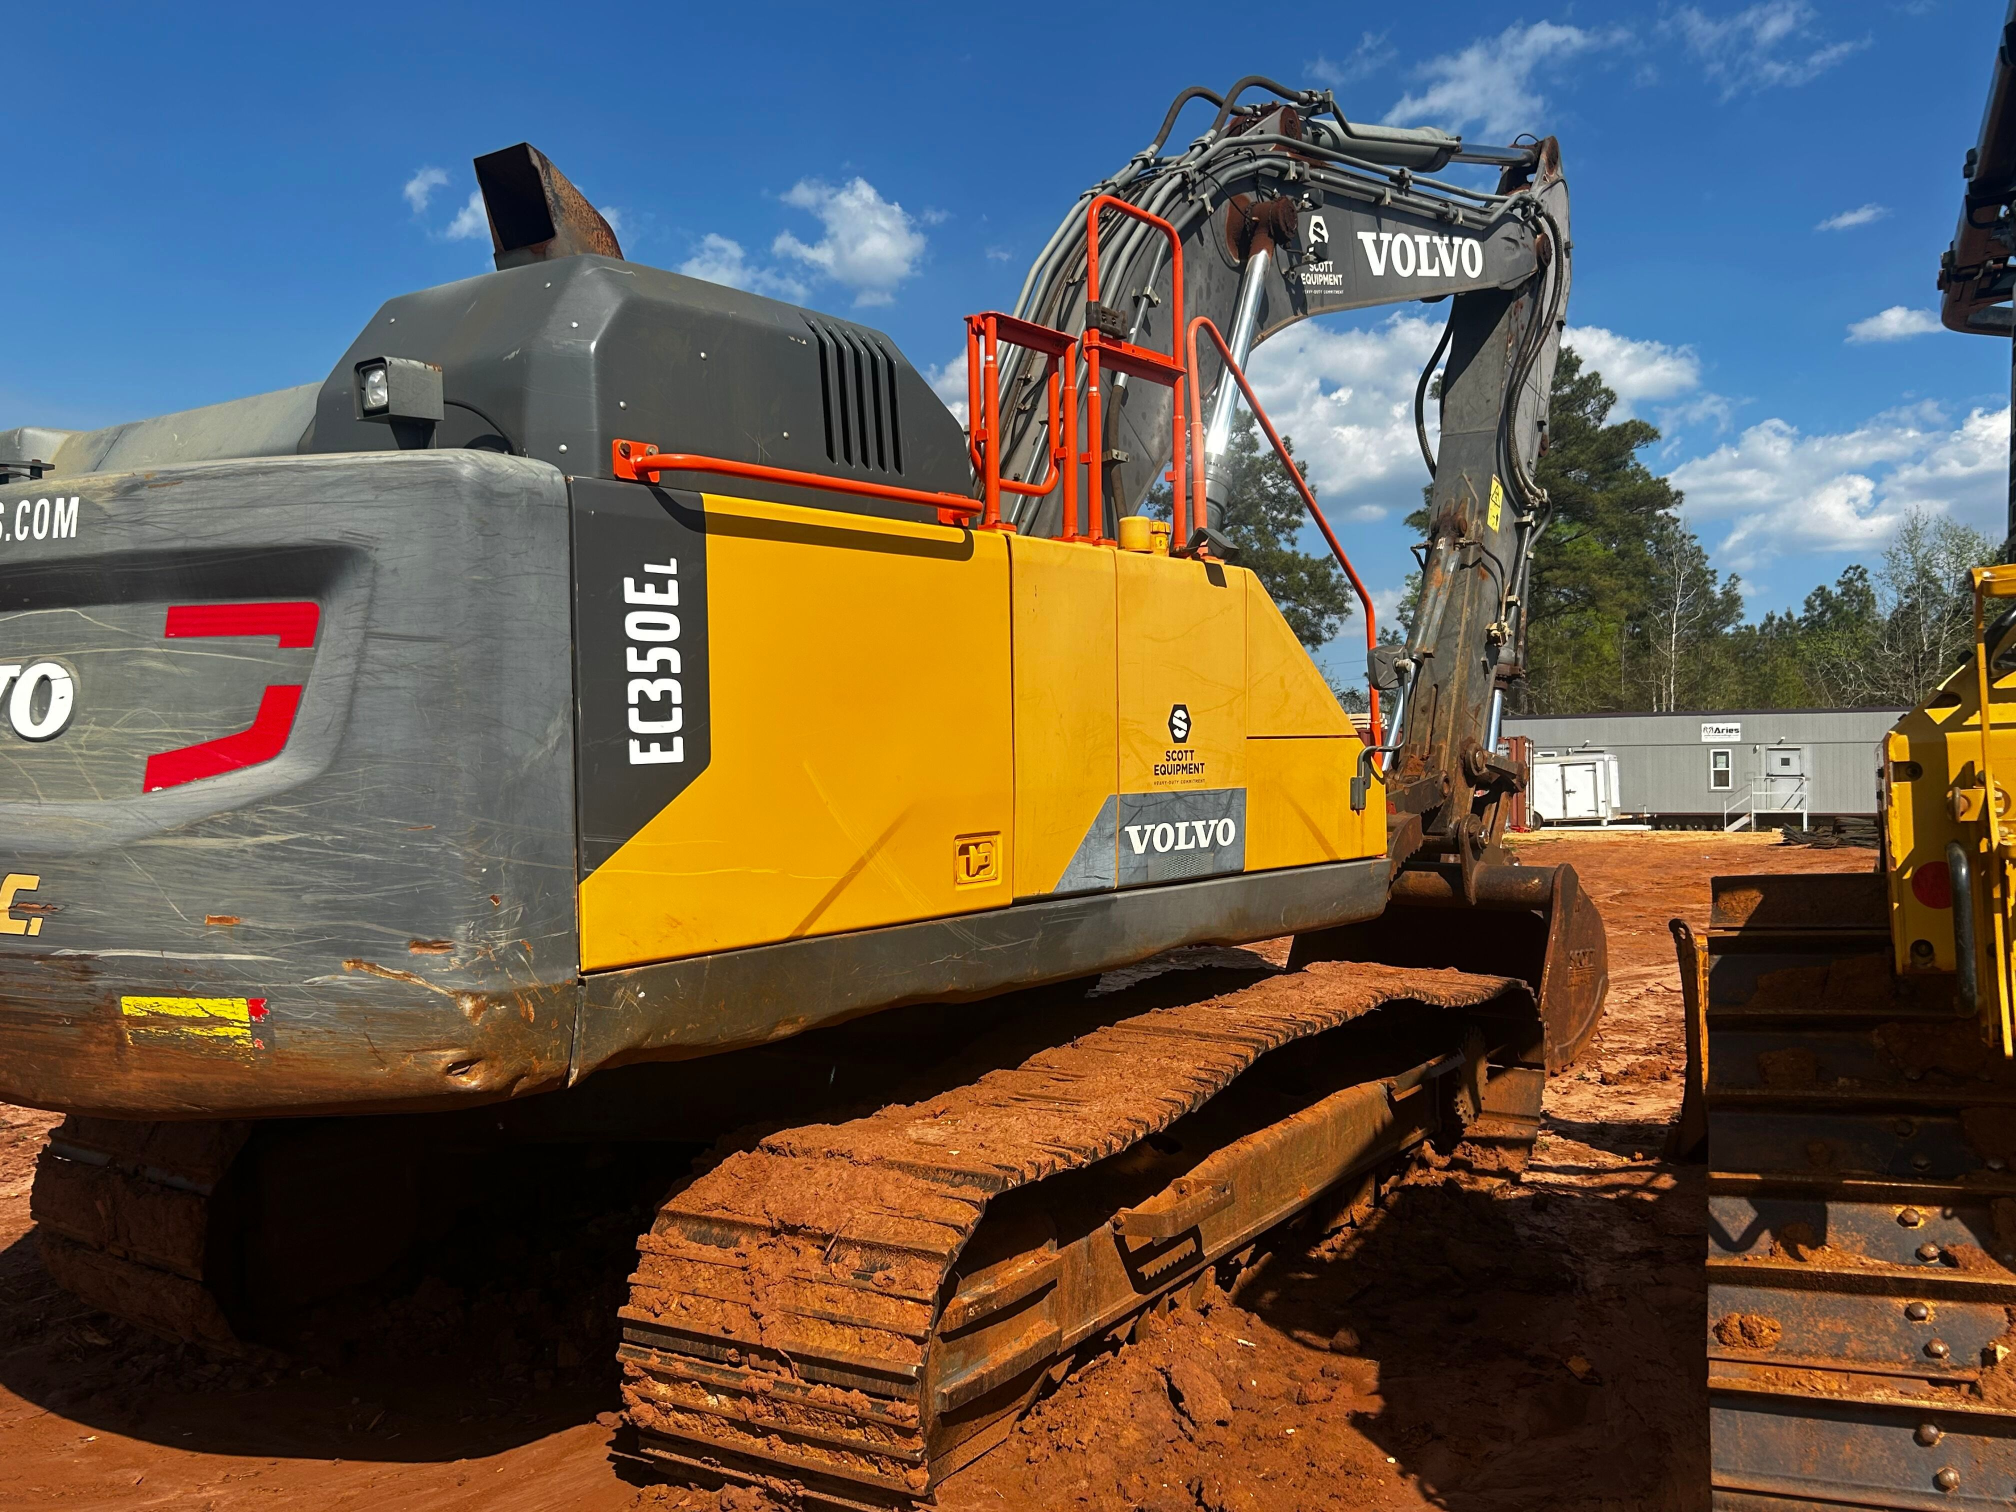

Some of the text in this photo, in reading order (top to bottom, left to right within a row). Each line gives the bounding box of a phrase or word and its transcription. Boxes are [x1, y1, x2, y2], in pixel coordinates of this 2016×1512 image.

[1357, 231, 1484, 279] VOLVO
[1309, 260, 1334, 273] SCOTT
[1301, 273, 1343, 286] EQUIPMENT
[623, 557, 684, 765] EC350EL
[1165, 749, 1195, 762] SCOTT
[1153, 762, 1206, 776] EQUIPMENT
[1124, 817, 1236, 855] VOLVO
